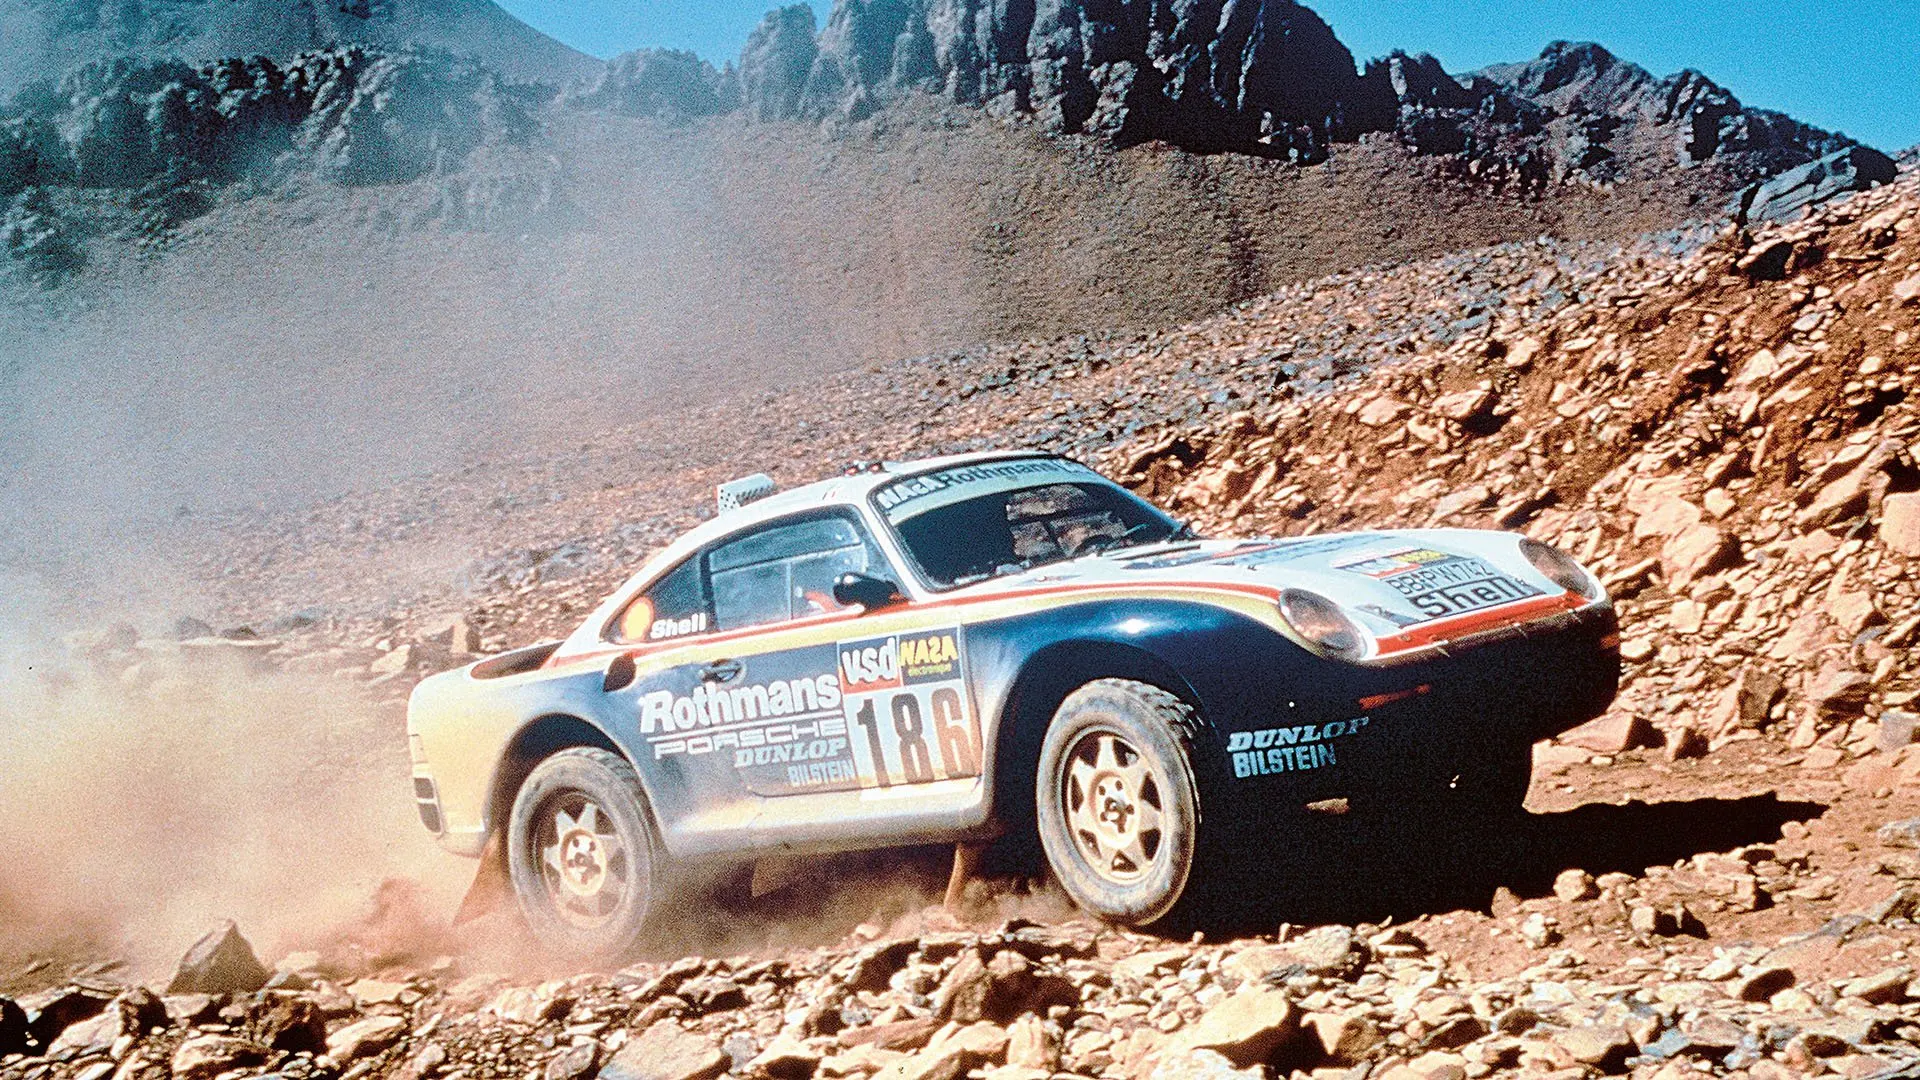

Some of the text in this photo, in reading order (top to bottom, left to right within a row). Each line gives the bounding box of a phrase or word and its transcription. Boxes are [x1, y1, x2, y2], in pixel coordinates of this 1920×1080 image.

[942, 461, 1058, 488] Rothmans
[1406, 578, 1527, 617] Shell
[650, 612, 706, 639] Shell
[638, 674, 842, 733] Rothmans
[654, 717, 847, 760] PORSCHE
[734, 737, 848, 768] DUNLOP
[857, 686, 973, 790] 186
[1227, 716, 1370, 753] DUNLOP
[788, 759, 855, 786] BILSTEIN
[1232, 743, 1337, 778] BILSTEIN
